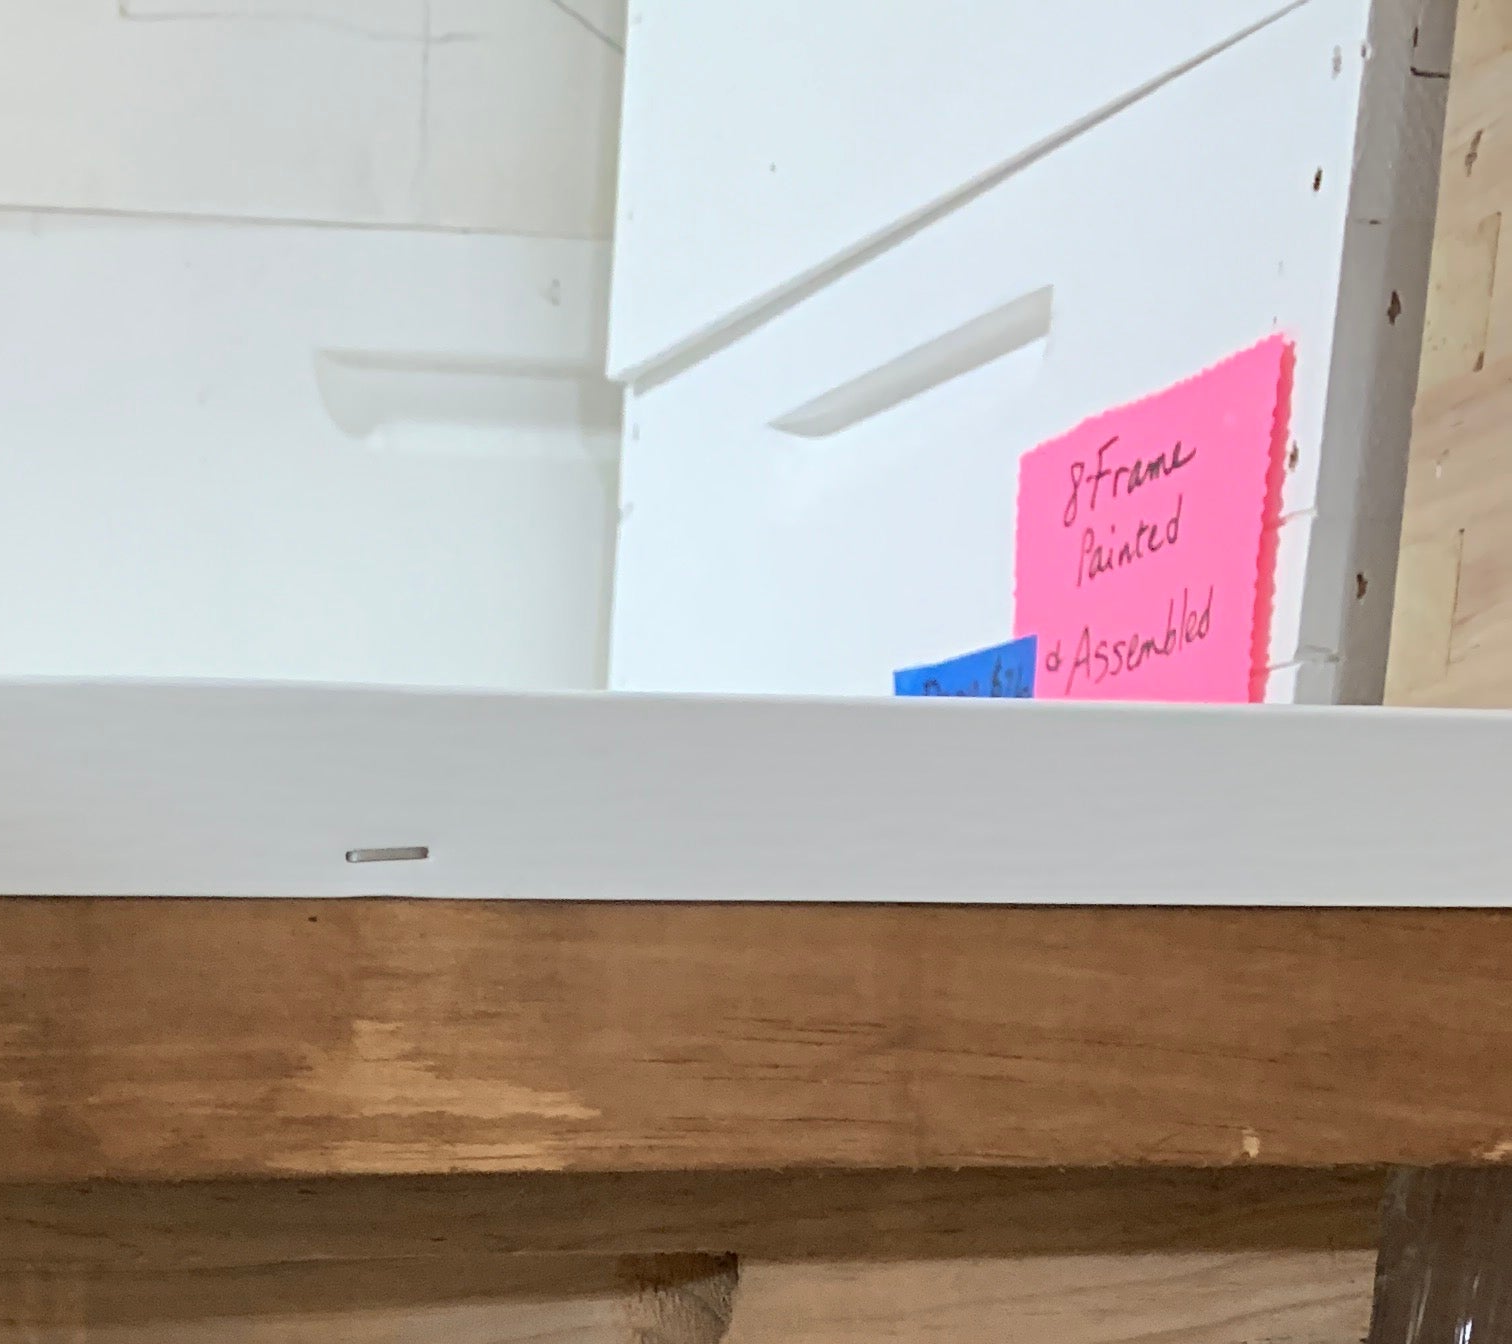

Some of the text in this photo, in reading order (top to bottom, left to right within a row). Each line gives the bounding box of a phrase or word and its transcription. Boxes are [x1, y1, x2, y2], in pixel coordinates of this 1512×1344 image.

[1085, 435, 1198, 511] Frame
[1076, 493, 1184, 588] Painted
[1064, 584, 1215, 696] Assembled
